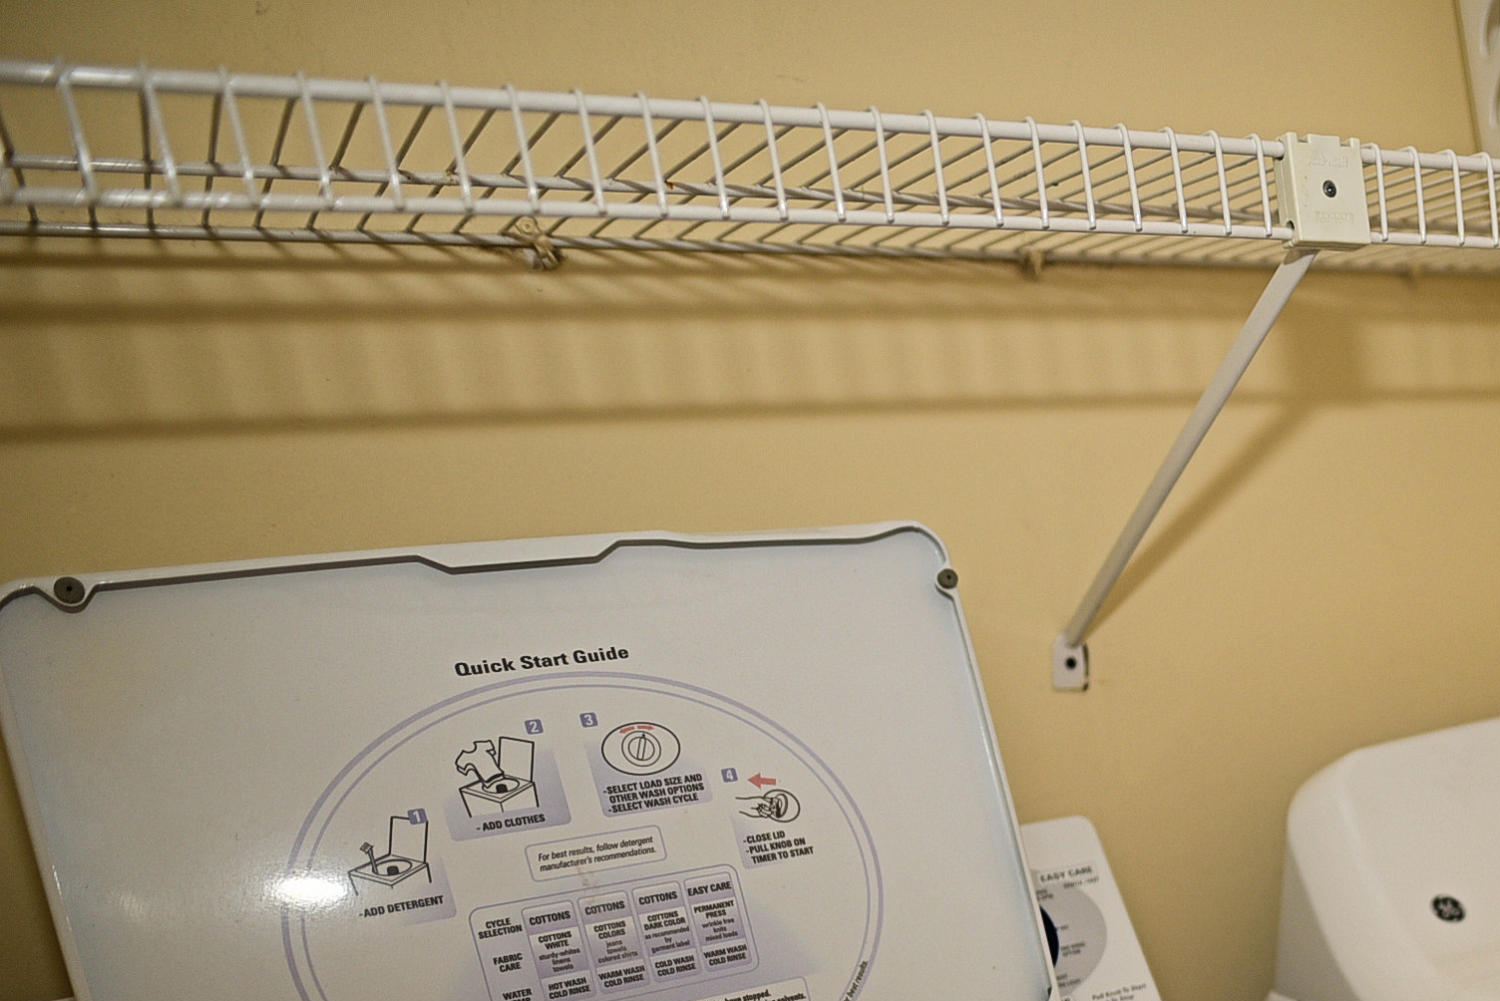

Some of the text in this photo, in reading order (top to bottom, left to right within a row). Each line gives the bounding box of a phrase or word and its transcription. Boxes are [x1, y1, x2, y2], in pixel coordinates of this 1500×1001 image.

[454, 647, 630, 676] Quick Start Guide
[640, 779, 662, 790] LOAD
[664, 776, 683, 786] SIZE
[684, 773, 702, 782] AND
[609, 782, 704, 804] OTHER WASH OPTIONS
[644, 797, 672, 808] WASH
[672, 792, 699, 803] CYCLE
[504, 814, 546, 828] CLOTHES
[773, 830, 786, 839] LID
[538, 852, 550, 862] For
[551, 848, 567, 859] best
[596, 842, 619, 852] follow
[620, 836, 653, 848] detergent
[770, 840, 792, 850] KNOB
[794, 838, 806, 846] ON
[751, 846, 814, 864] TIMER TO START
[688, 881, 732, 897] EASY CARE
[387, 895, 444, 914] DETERGENT
[639, 891, 678, 905] COTTONS
[585, 900, 626, 915] COTTONS
[485, 918, 511, 929] CYCLE
[529, 911, 571, 926] COTTONS
[647, 911, 679, 922] COTTONS
[594, 920, 626, 933] COTTONS
[644, 917, 685, 931] DARK COLOR
[478, 924, 523, 940] SELECTION
[538, 931, 572, 943] COTTONS
[598, 929, 626, 940] COLORS
[544, 940, 570, 950] WHITE
[704, 944, 747, 959] WARM WASH
[492, 953, 523, 966] FABRIC
[655, 955, 694, 969] COLD WASH
[709, 952, 746, 966] COLD RINSE
[500, 962, 522, 973] CARE
[598, 965, 645, 980] WARM WASH
[657, 963, 696, 977] COLD RINSE
[548, 977, 587, 991] HOT WASH
[604, 974, 644, 988] COLD RINSE
[502, 988, 532, 1000] WATER
[549, 985, 591, 1000] COLD RINSE
[743, 989, 771, 1001] stopped.
